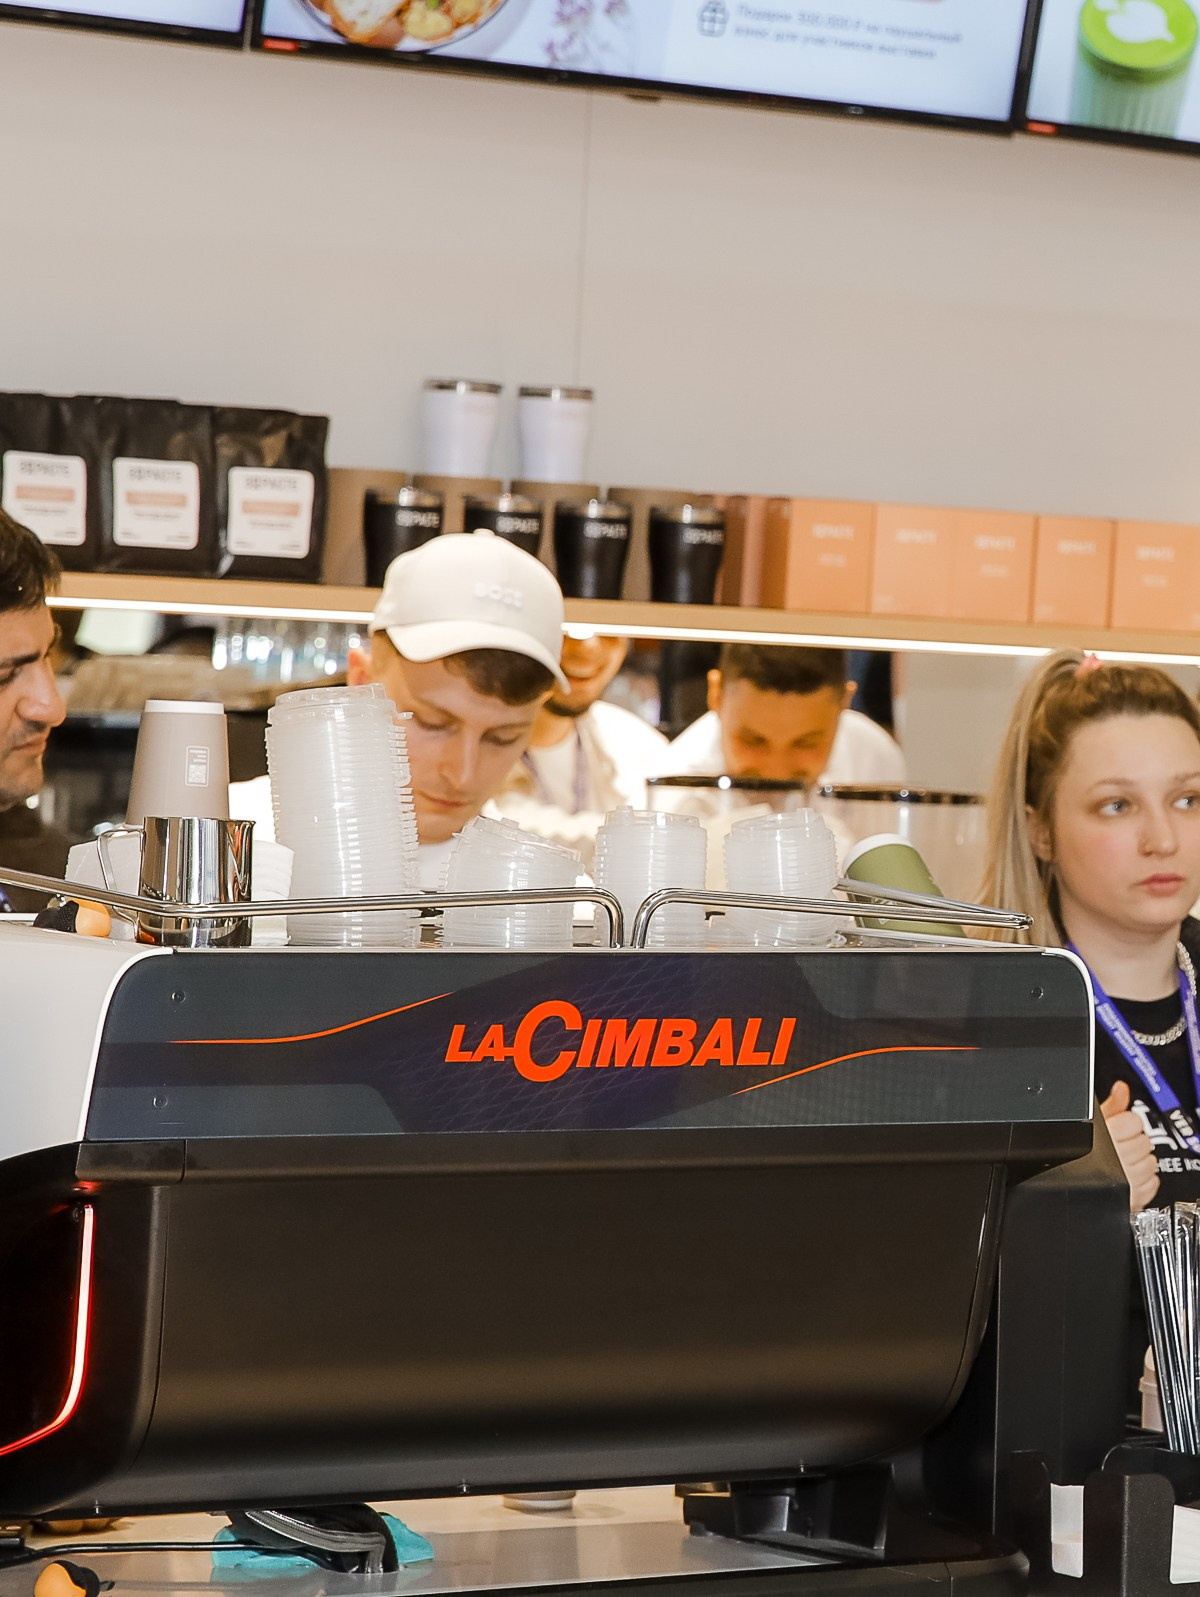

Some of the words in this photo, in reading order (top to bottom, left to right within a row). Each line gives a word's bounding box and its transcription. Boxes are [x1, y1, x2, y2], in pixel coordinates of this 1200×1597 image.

[444, 1023, 515, 1062] LA
[513, 1000, 796, 1082] CIMBALI
[1155, 1157, 1183, 1172] НЕЕ
